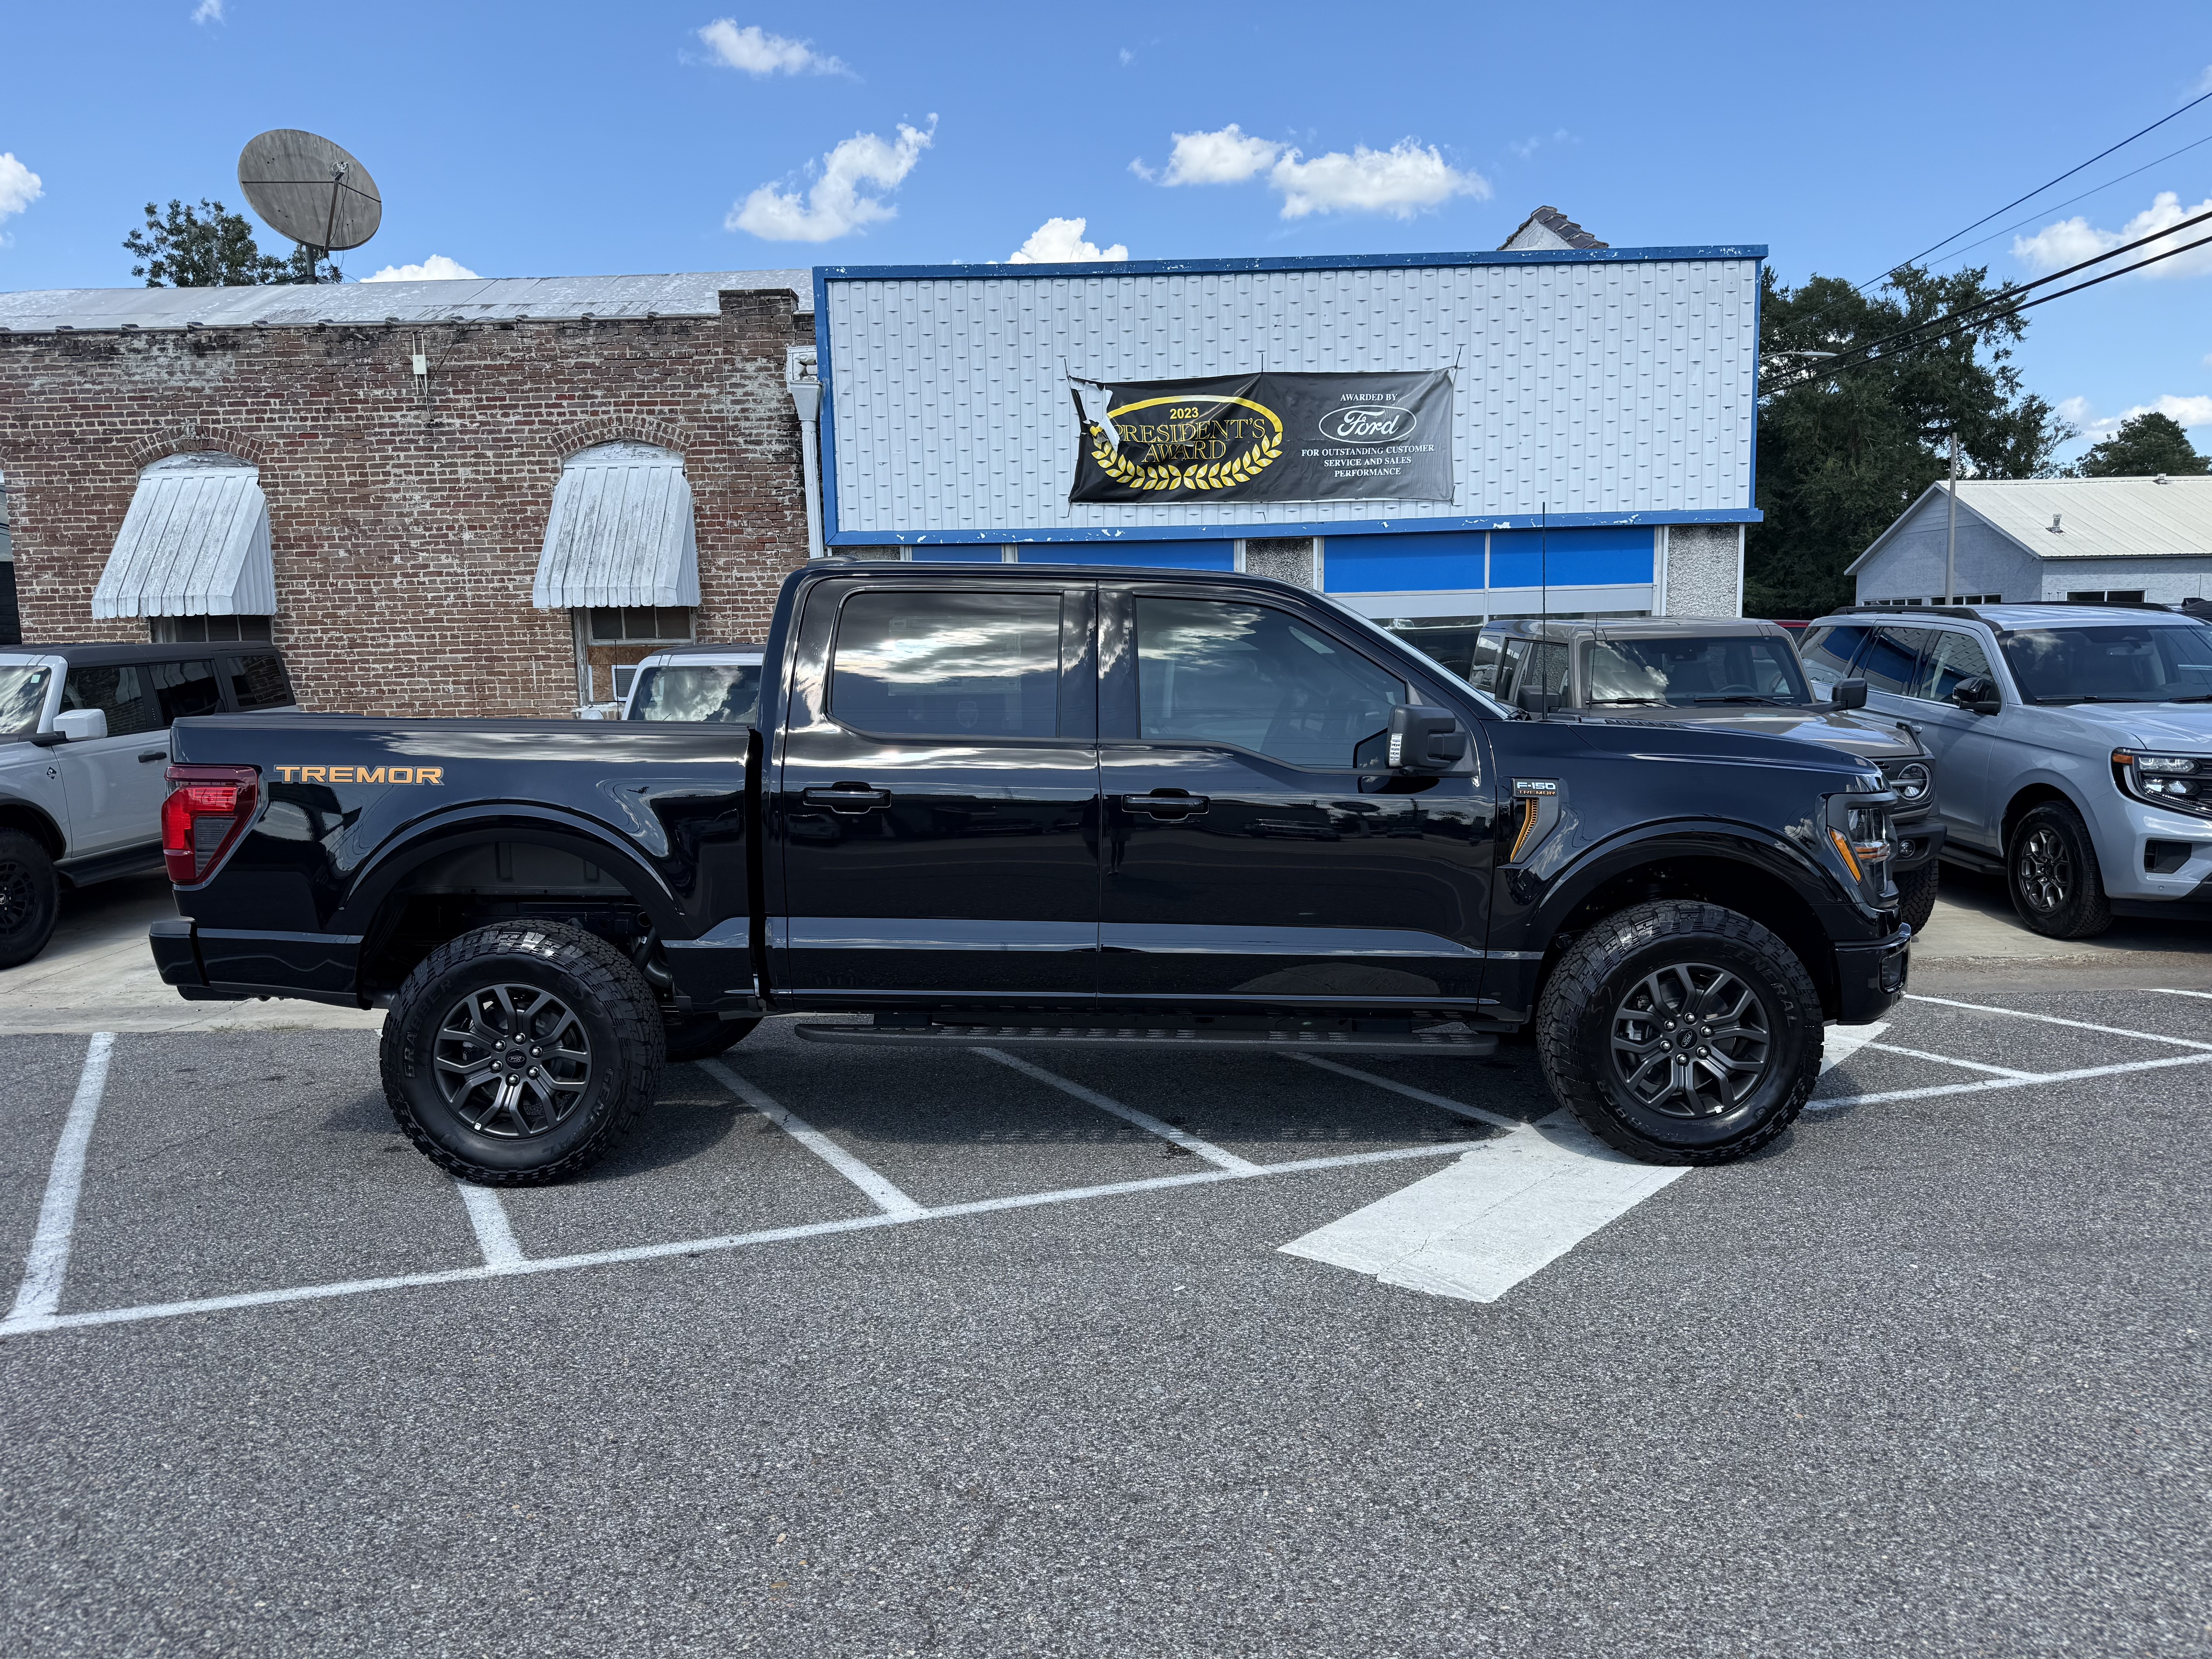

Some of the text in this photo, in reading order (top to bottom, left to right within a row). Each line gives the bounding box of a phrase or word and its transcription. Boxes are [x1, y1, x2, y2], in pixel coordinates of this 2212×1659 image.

[1170, 407, 1199, 419] 2023
[1337, 410, 1400, 436] Ford
[1141, 440, 1226, 462] AWARD
[1301, 445, 1435, 457] FOR OUTSTANDING CUSTOMER
[1324, 456, 1412, 467] SERVICE AND SALES
[1334, 467, 1401, 477] PERFORMANCE
[275, 766, 443, 785] TREMOR
[1517, 781, 1556, 790] F-150
[1718, 941, 1800, 1027] GENERAL
[404, 977, 453, 1079] GRABBER
[542, 1067, 613, 1158] GENERAL
